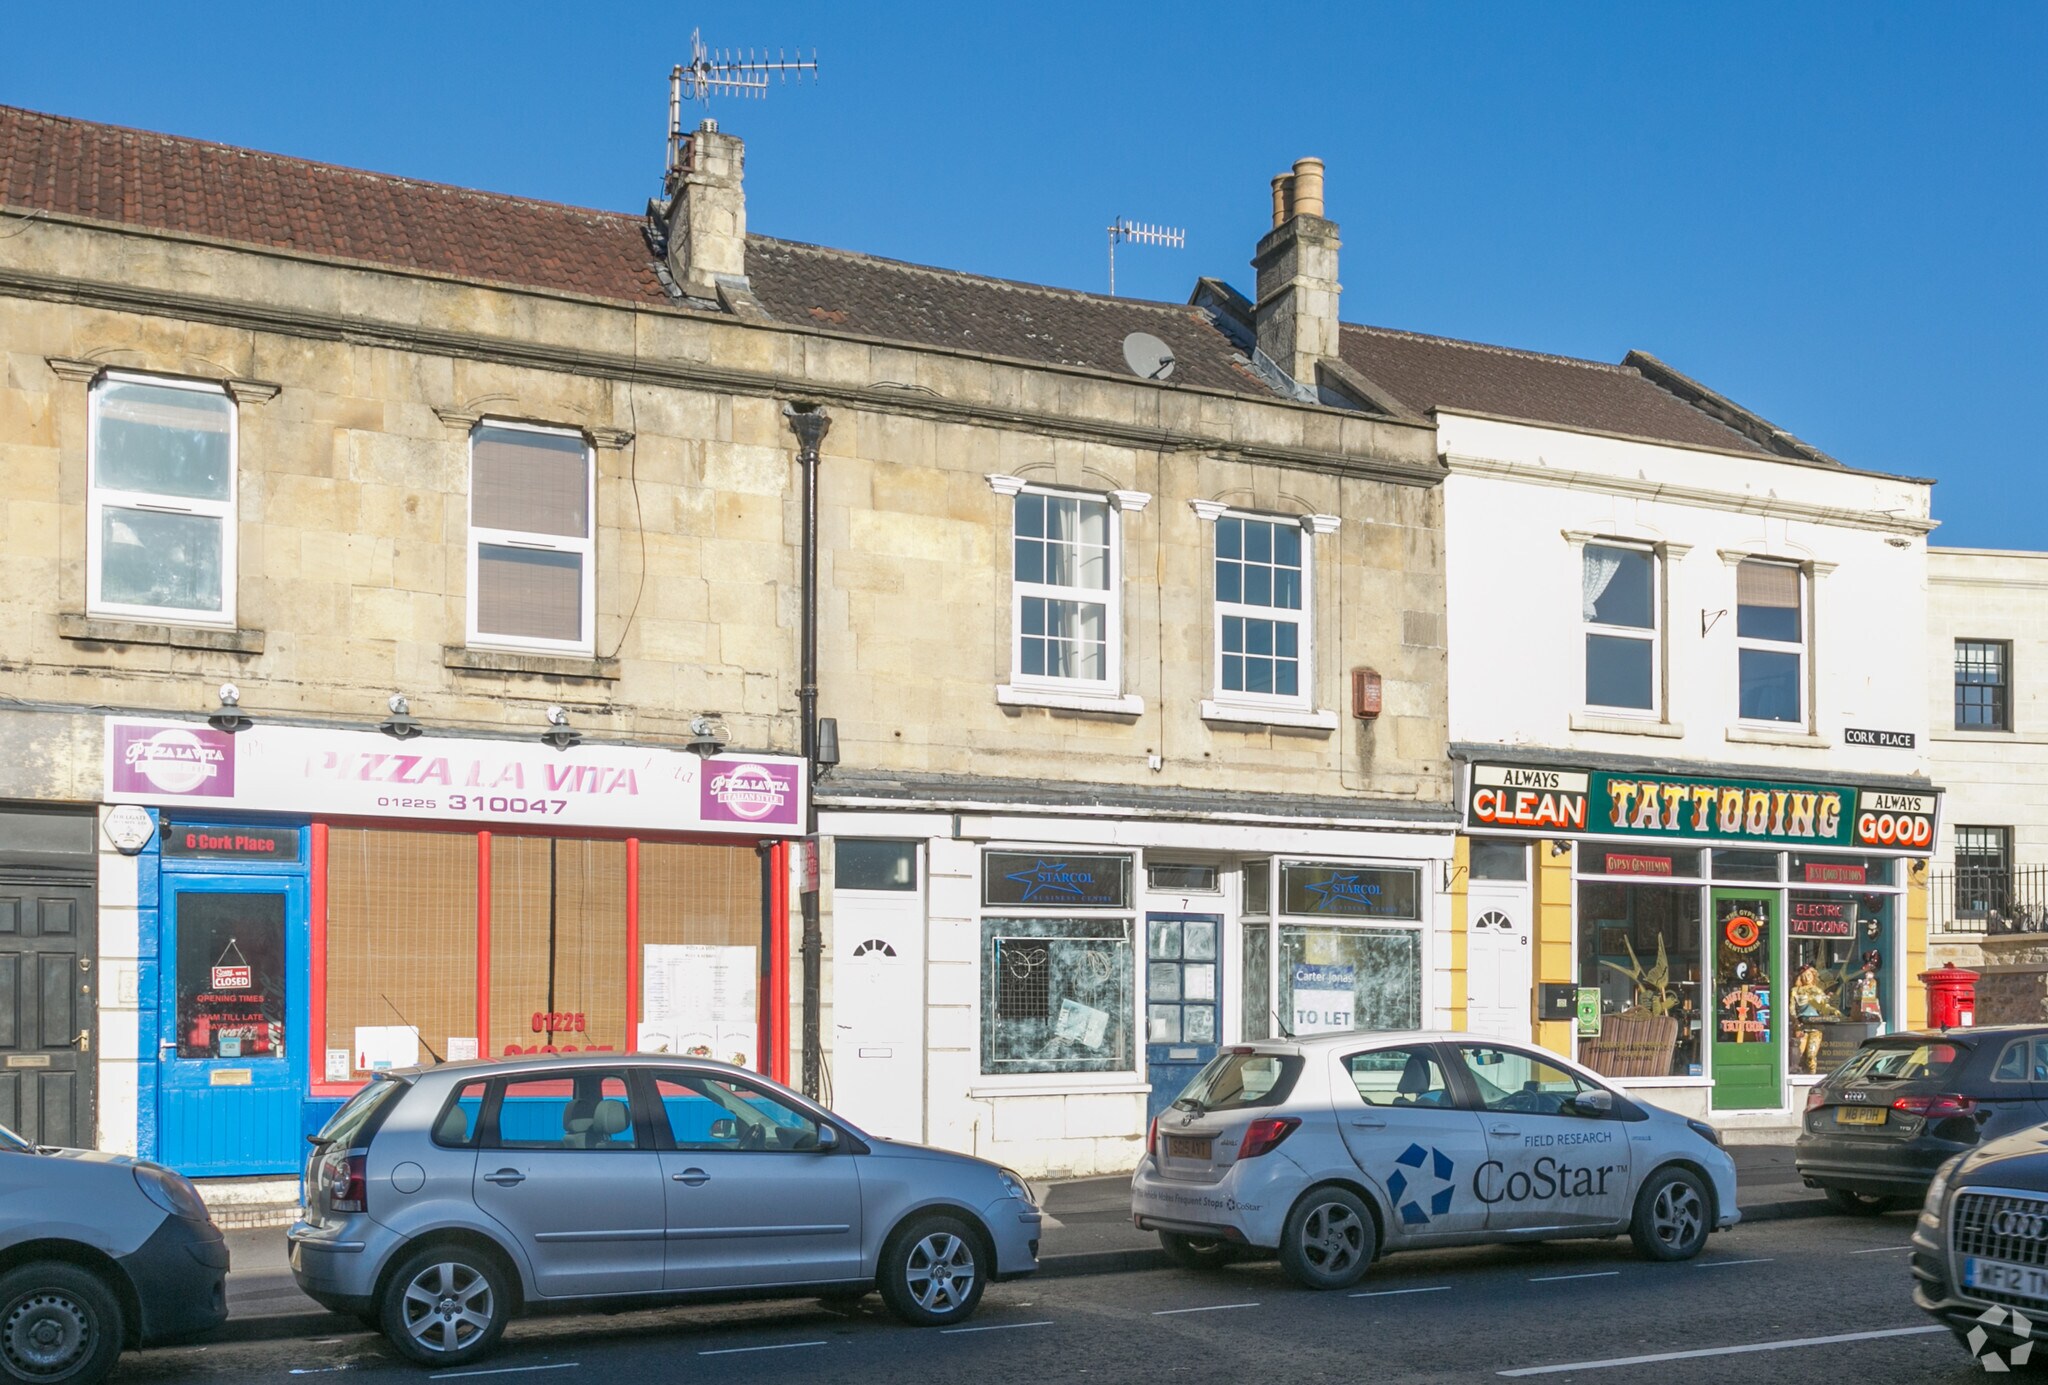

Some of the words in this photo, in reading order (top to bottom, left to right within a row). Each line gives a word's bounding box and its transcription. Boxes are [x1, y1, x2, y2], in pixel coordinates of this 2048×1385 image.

[1846, 730, 1875, 744] CORK
[1880, 733, 1911, 747] PLACE
[305, 751, 453, 785] PIZZA
[465, 760, 524, 789] LA
[544, 763, 638, 795] VITA
[1503, 769, 1560, 788] ALWAYS
[377, 797, 437, 809] 01225
[448, 794, 568, 815] 310047
[1473, 788, 1586, 828] CLEAN
[1607, 779, 1841, 838] TATTOOING
[1874, 794, 1922, 811] ALWAYS
[1858, 812, 1932, 847] GOOD
[186, 833, 196, 849] 6
[198, 833, 233, 850] Cork
[235, 835, 275, 851] Place
[1608, 856, 1631, 871] GYPSY
[1631, 857, 1670, 873] GENTLEMAN
[1037, 871, 1095, 883] STARCOL
[1332, 883, 1383, 895] STARCOL
[1181, 899, 1189, 910] 7
[1796, 903, 1844, 917] ELECTRIC
[1790, 918, 1849, 934] TATTOOING
[1520, 935, 1528, 945] 8
[1724, 939, 1761, 953] GENTLEMAN
[215, 976, 249, 987] CLOSED
[1296, 970, 1325, 982] Carter
[1327, 972, 1354, 984] Jonas
[197, 994, 237, 1003] OPENING
[239, 994, 265, 1003] TIMES
[222, 1013, 240, 1021] TILL
[242, 1013, 264, 1021] LATE
[531, 1011, 586, 1033] 01225
[1296, 1010, 1319, 1024] TO
[1324, 1011, 1351, 1025] LET
[1524, 1135, 1554, 1148] FIELD
[1557, 1131, 1612, 1146] RESEARCH
[1472, 1156, 1614, 1204] CoStar
[1175, 1193, 1202, 1206] Frequent
[1202, 1196, 1223, 1209] Stops
